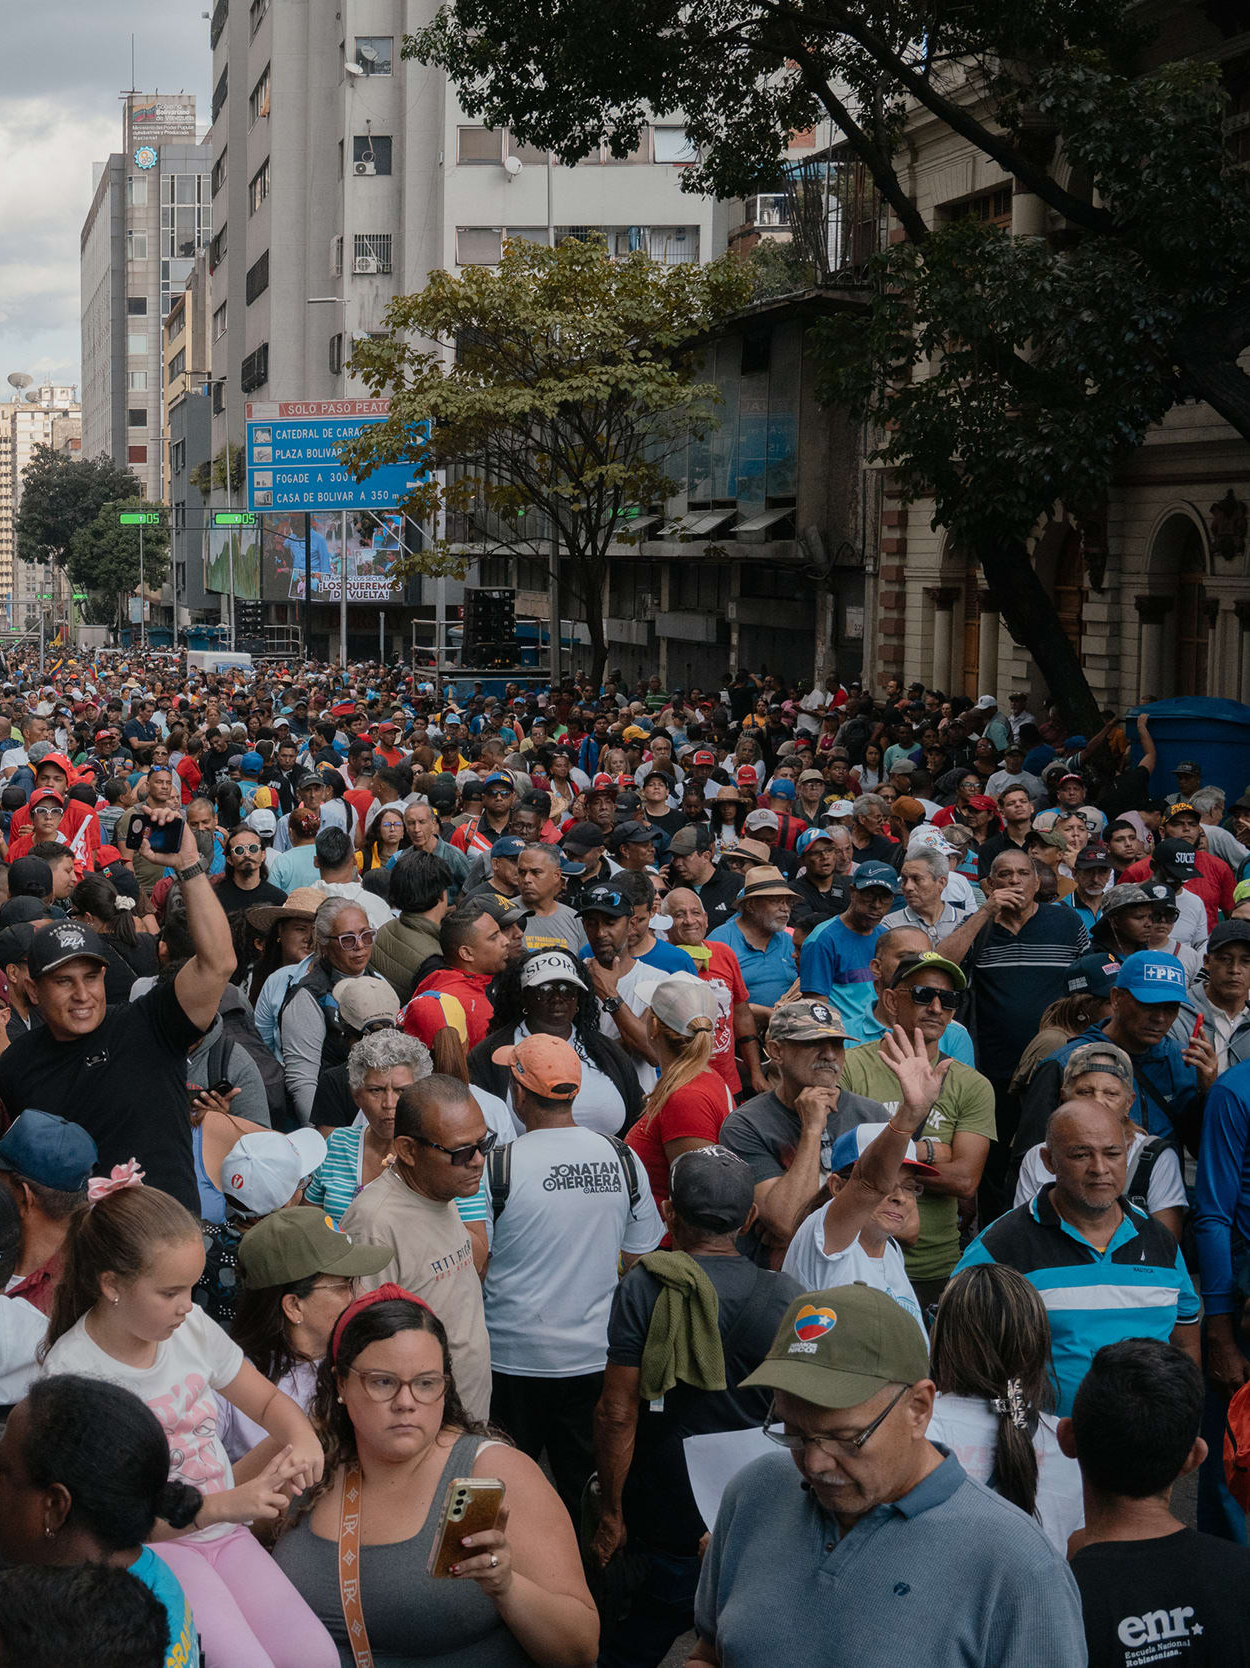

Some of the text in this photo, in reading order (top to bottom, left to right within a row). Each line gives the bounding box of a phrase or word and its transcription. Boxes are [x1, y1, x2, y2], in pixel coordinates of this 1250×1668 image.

[288, 402, 317, 414] SOLO
[321, 401, 351, 413] PASO
[275, 428, 319, 440] CATEDRAL
[322, 427, 334, 438] DE
[275, 448, 303, 459] PLAZA
[276, 474, 310, 484] FOGADE
[317, 473, 323, 482] A
[330, 472, 349, 482] 300
[276, 493, 301, 503] CASA
[303, 492, 314, 502] DE
[317, 491, 354, 502] BOLIVAR
[360, 491, 366, 500] A
[370, 491, 389, 500] 350
[242, 513, 255, 524] 05
[349, 590, 389, 600] VUELTA!
[549, 1162, 620, 1179] JONATAN
[556, 1174, 622, 1191] HERRERA
[589, 1185, 622, 1194] ALCALDE
[1124, 1639, 1191, 1660] Escuela Nacional
